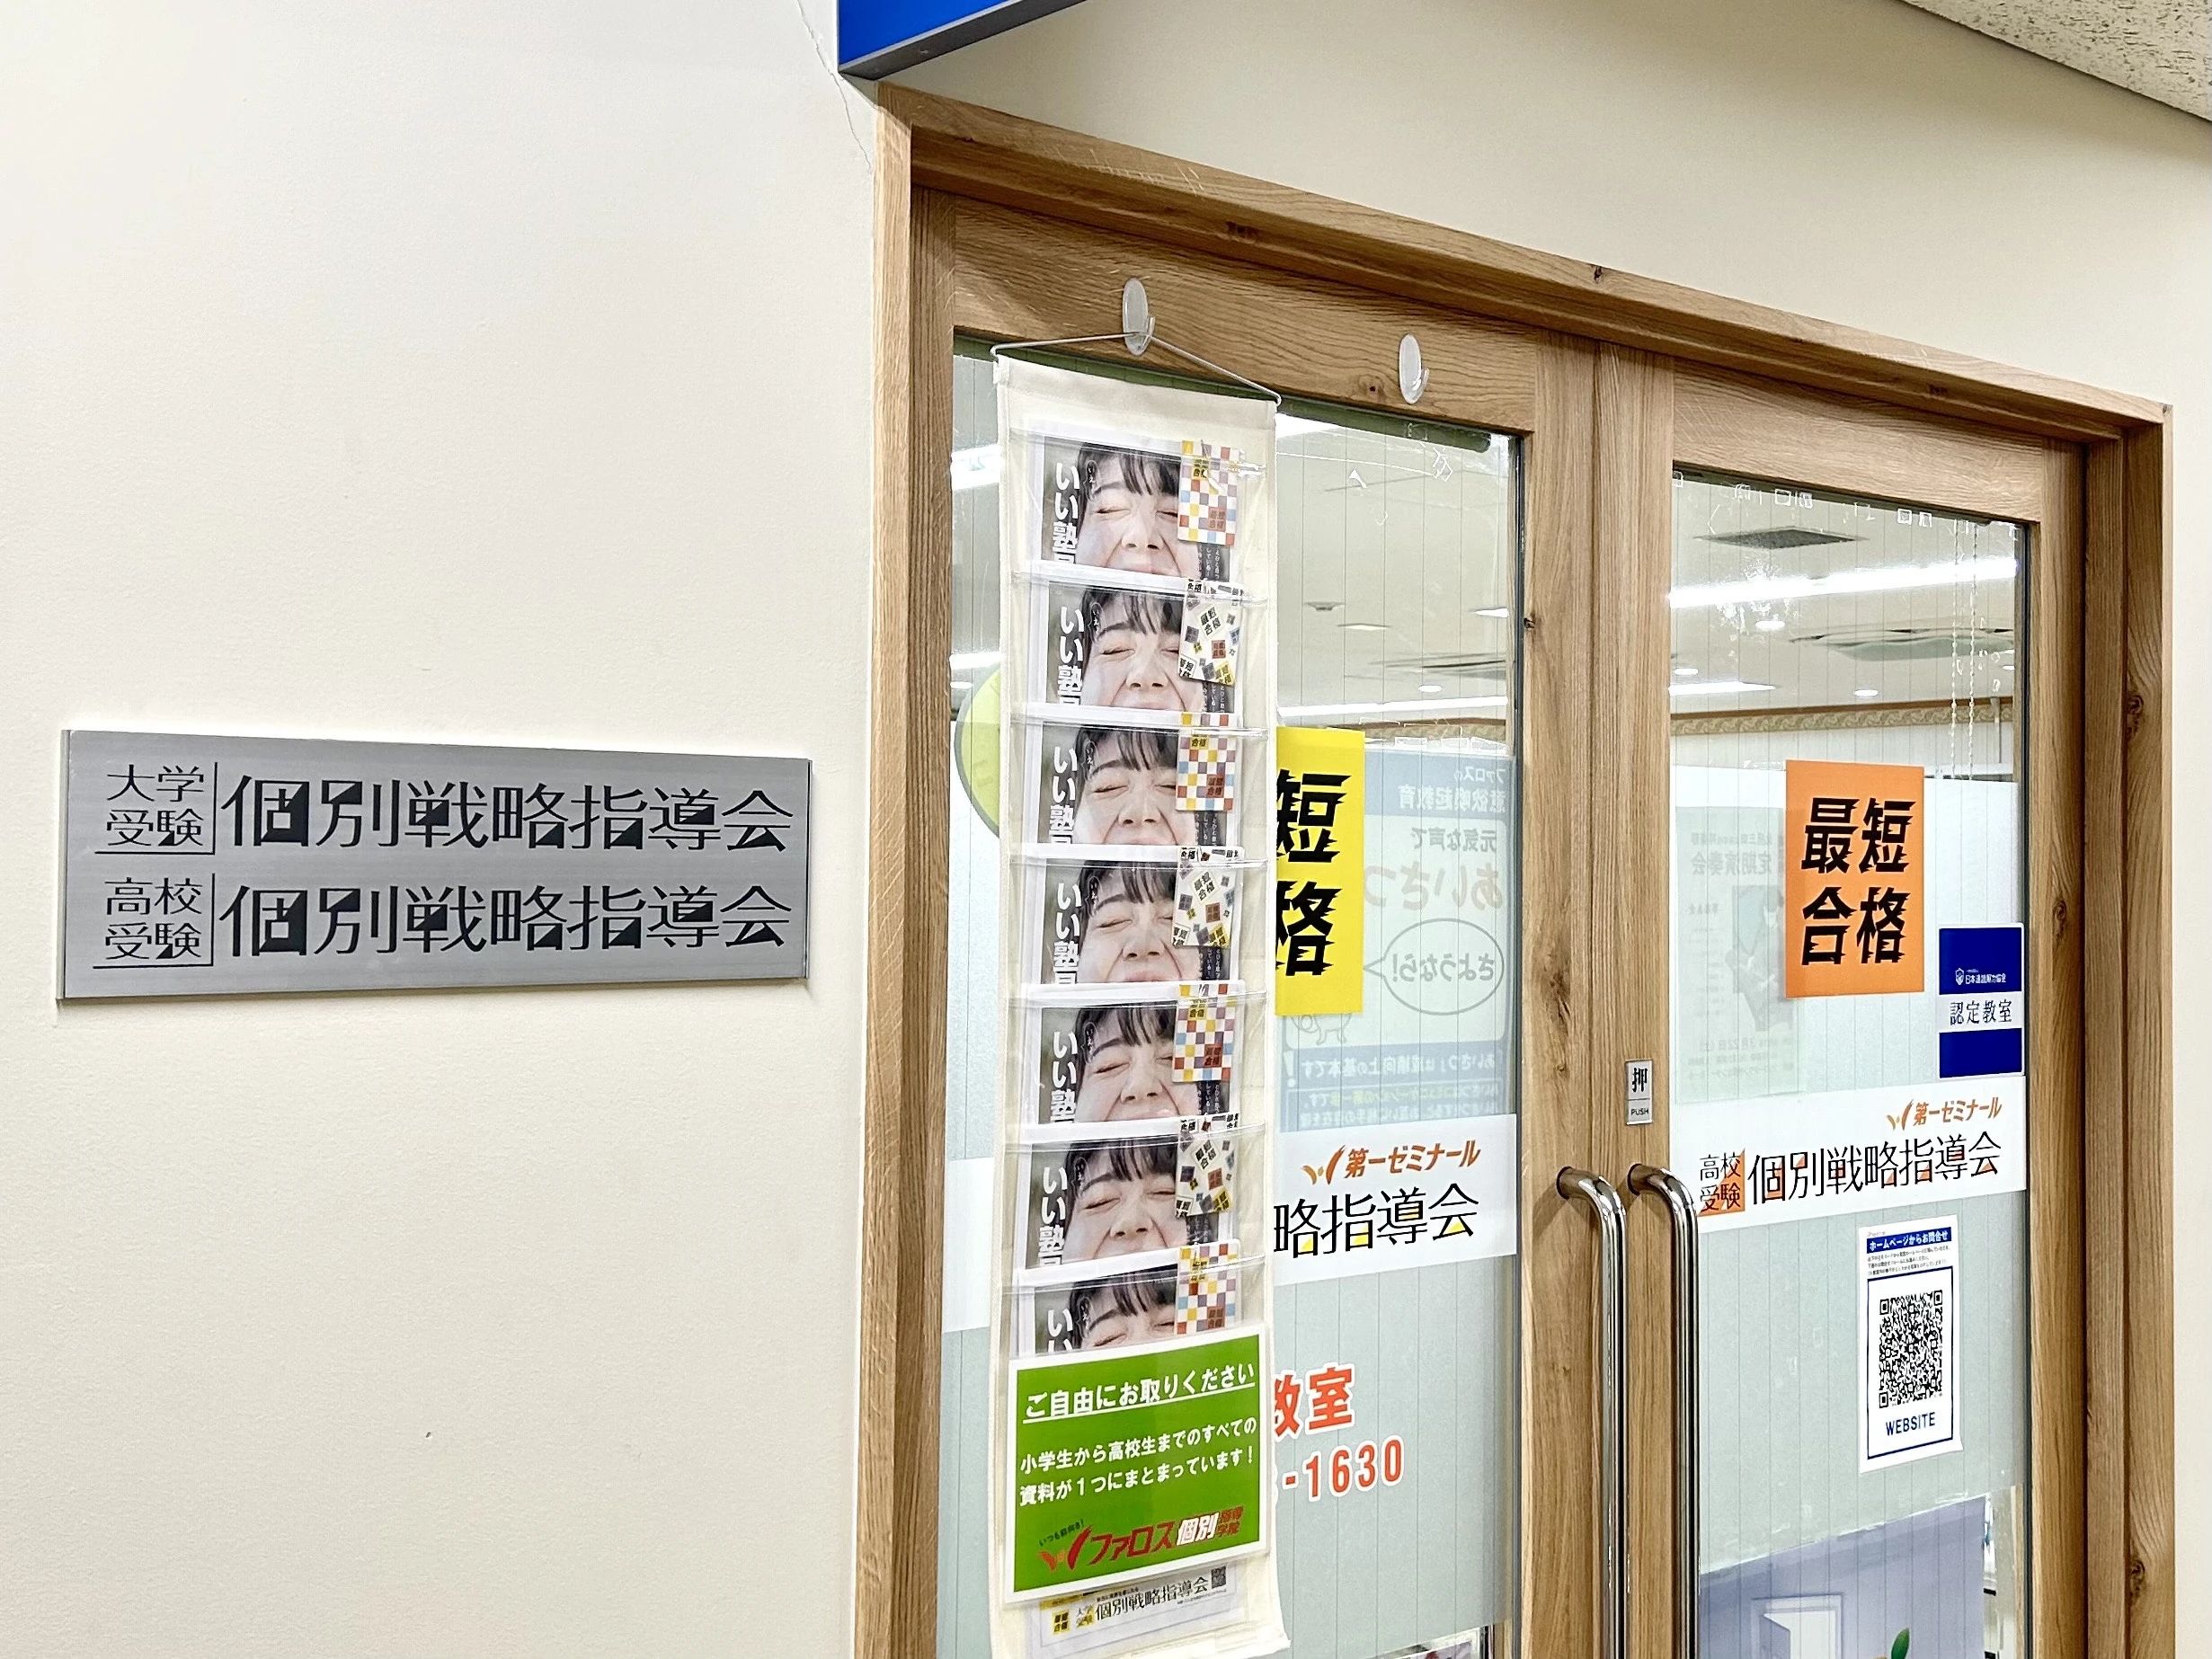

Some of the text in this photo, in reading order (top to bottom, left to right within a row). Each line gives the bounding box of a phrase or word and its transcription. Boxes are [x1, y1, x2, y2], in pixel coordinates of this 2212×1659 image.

[1052, 462, 1080, 564] いい塾
[1057, 607, 1084, 705] いい塾
[106, 763, 206, 803] 大学
[1049, 746, 1078, 845] いい塾
[106, 807, 203, 850] 受験
[220, 771, 795, 853] 個別戦略指導会
[1276, 768, 1352, 863] 短
[1801, 797, 1917, 874] 最短
[105, 875, 201, 917] 高校
[218, 883, 795, 957] 個別戦略指導会
[105, 921, 200, 962] 受験
[1053, 883, 1083, 985] いい塾
[1801, 886, 1912, 966] 合格
[1950, 999, 2012, 1025] 認定教室
[1631, 1067, 1648, 1093] 押
[1630, 1107, 1649, 1116] PUSH
[1913, 1096, 2003, 1128] 第一ゼミナール
[1344, 1140, 1482, 1179] 第一ゼミナール
[1700, 1151, 1742, 1182] 高校
[1747, 1131, 2002, 1205] 個別戦略指導会
[1274, 1182, 1479, 1258] 略指導会
[1700, 1184, 1742, 1213] 受験
[1026, 1362, 1255, 1418] ご自由にお取りください
[1020, 1416, 1257, 1475] 小学生から高校生までのすべての
[1885, 1412, 1936, 1437] WEBSITE
